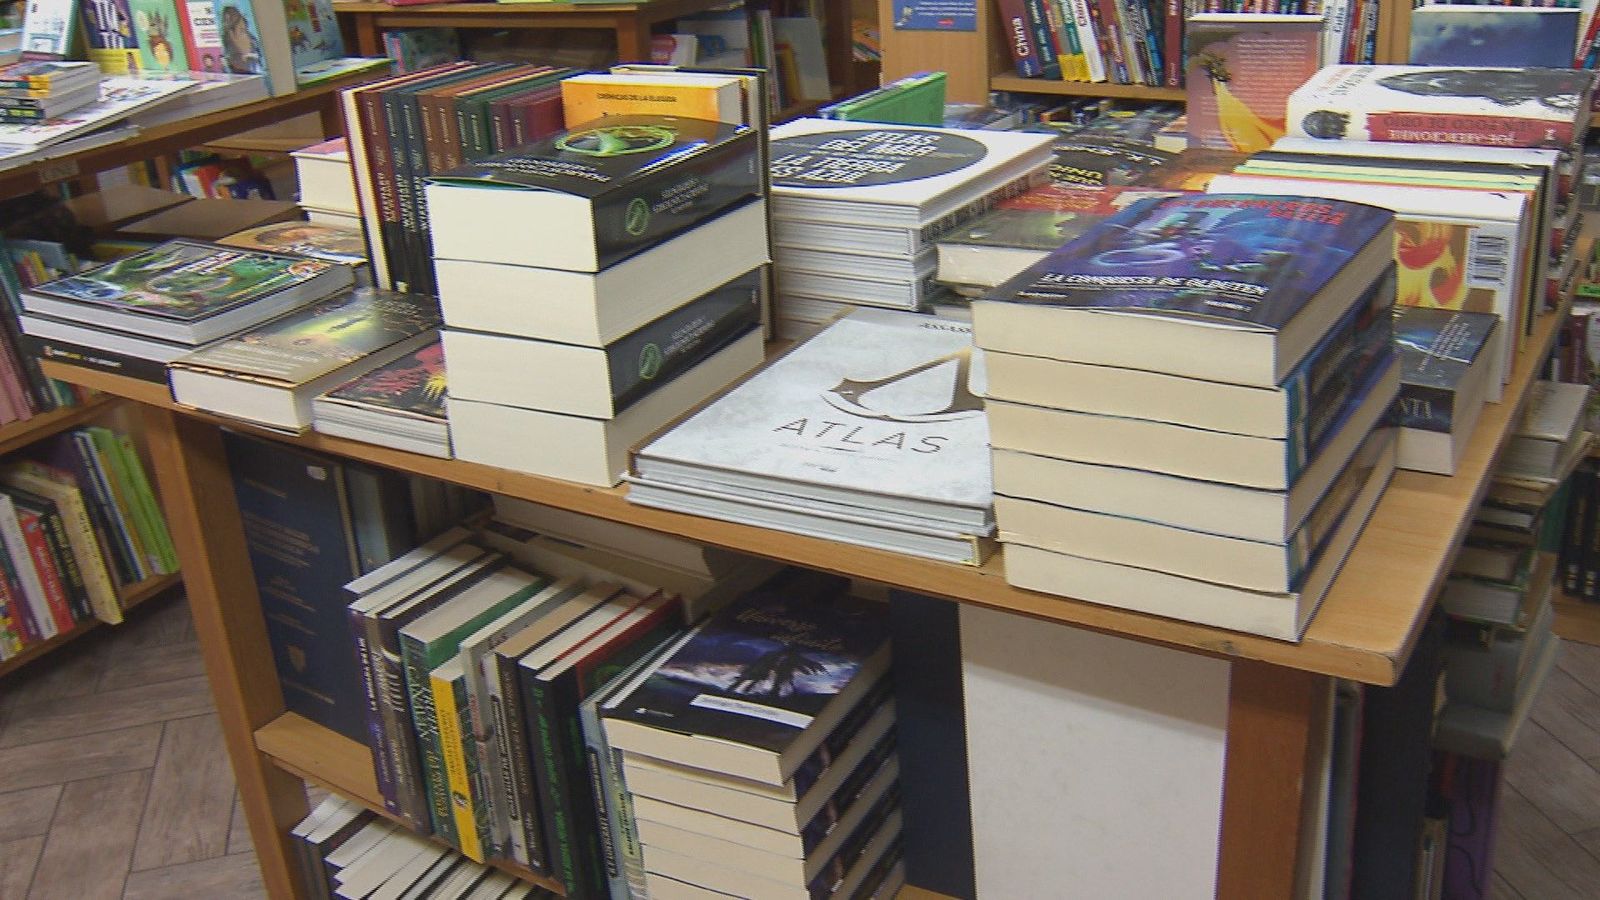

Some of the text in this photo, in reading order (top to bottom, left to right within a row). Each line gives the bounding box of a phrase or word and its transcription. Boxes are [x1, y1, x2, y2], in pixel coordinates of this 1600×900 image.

[1012, 17, 1030, 57] China
[855, 131, 942, 146] ATLAS
[1041, 273, 1063, 284] LA
[1156, 276, 1182, 287] DE
[772, 417, 949, 454] ATLAS
[403, 665, 433, 742] CANAVAN
